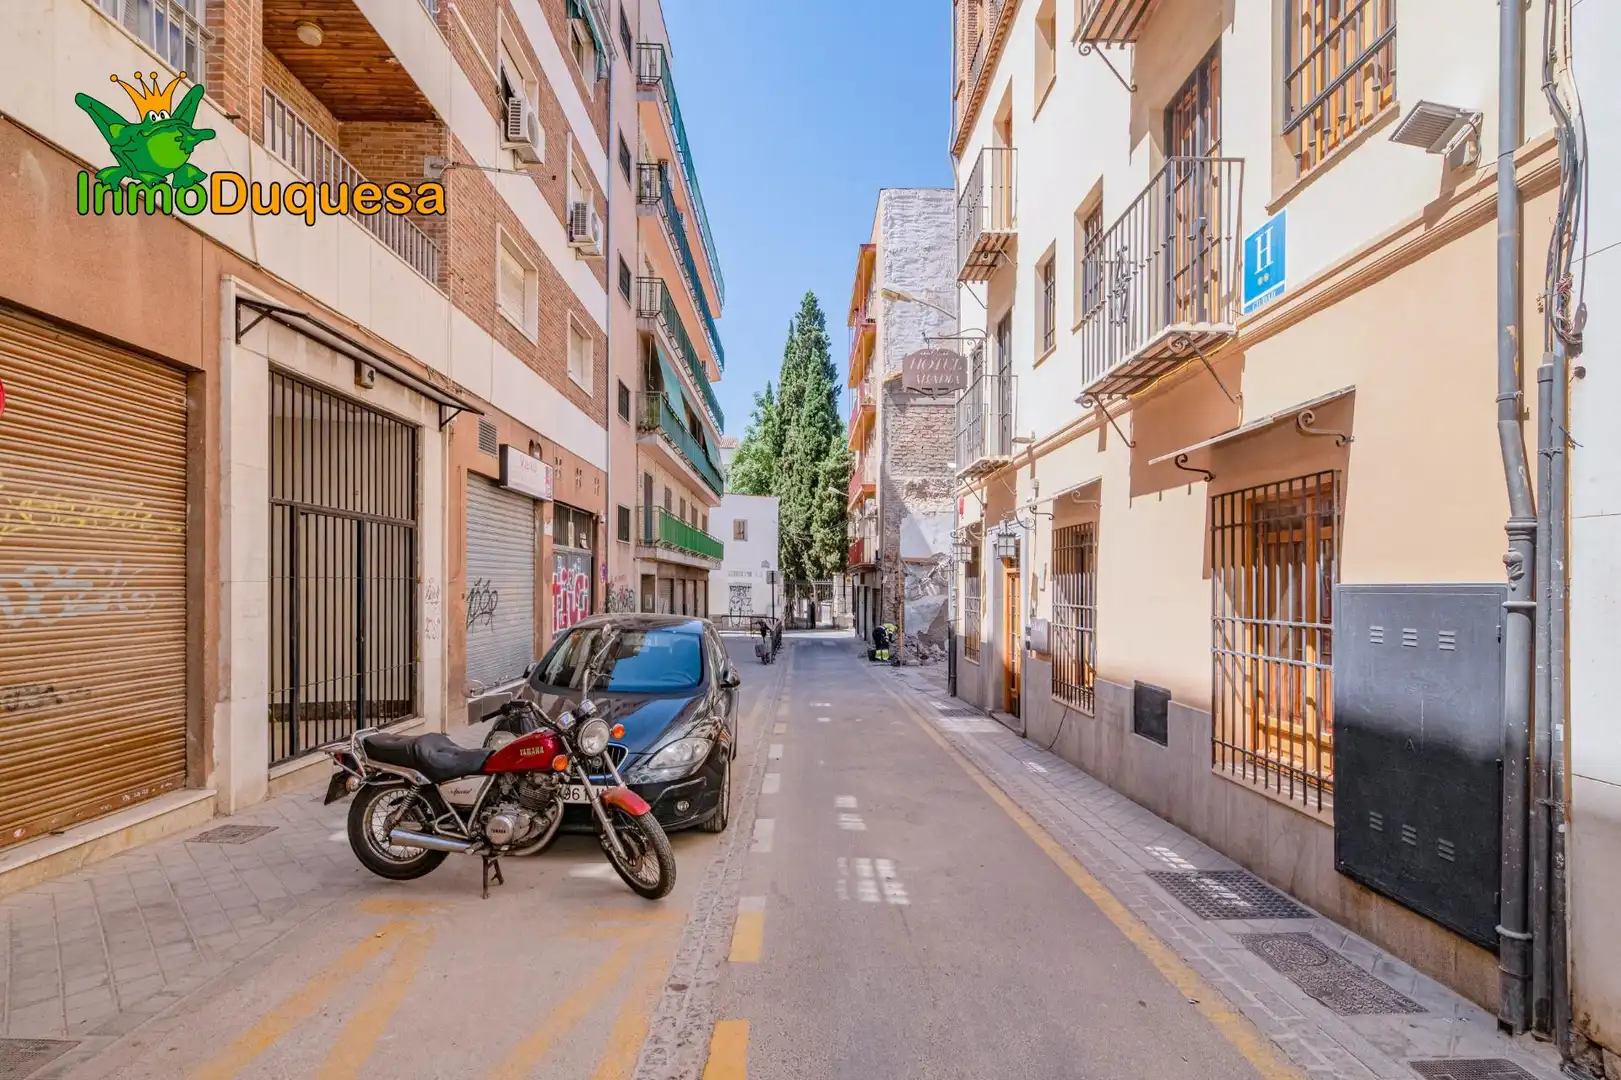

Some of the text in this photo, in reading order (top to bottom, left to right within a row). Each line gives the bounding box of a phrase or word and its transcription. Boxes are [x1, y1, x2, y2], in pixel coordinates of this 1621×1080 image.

[1254, 226, 1274, 275] H
[909, 357, 962, 370] HOTEL
[519, 746, 545, 757] YAMAHA
